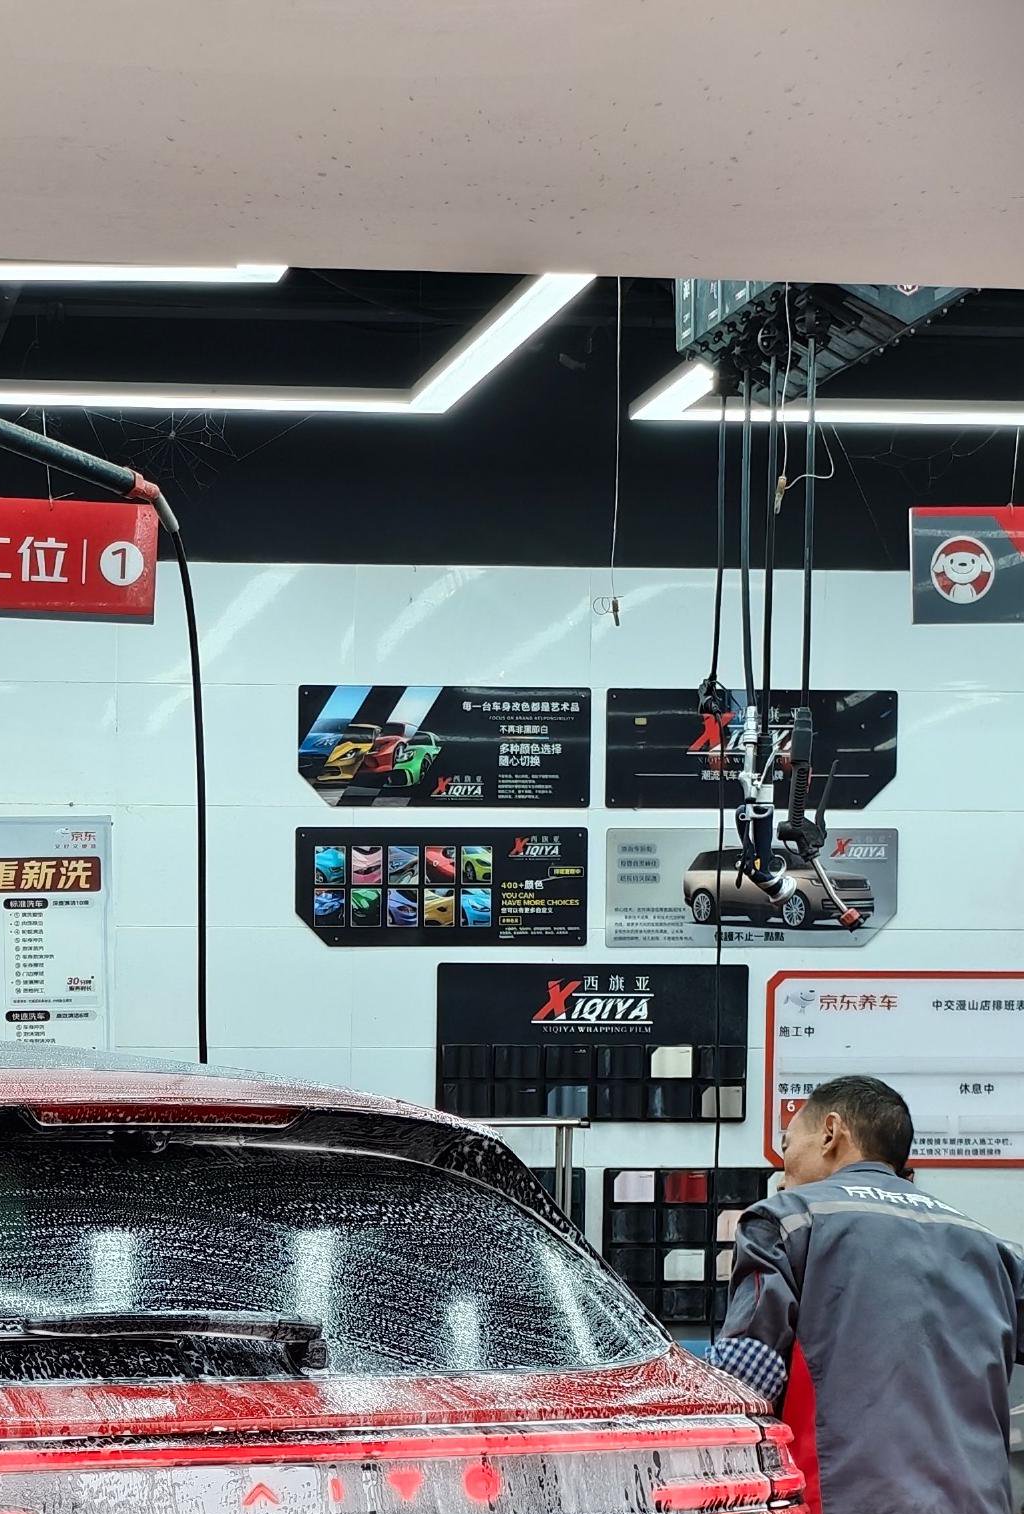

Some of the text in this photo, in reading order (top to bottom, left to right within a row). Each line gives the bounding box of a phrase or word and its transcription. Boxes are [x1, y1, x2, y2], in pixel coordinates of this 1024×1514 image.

[462, 701, 580, 713] 每一台车身改色都是艺术品
[499, 743, 563, 755] 多种颜色选择
[498, 755, 541, 767] 随心切换
[70, 831, 97, 842] 京东
[583, 974, 651, 992] 西旗亚
[532, 977, 652, 1021] XIQIYA
[819, 993, 898, 1012] 京东养车
[542, 1025, 652, 1034] XIQIYA WRAPPING FILM
[779, 1025, 816, 1038] 施工中
[959, 1082, 995, 1095] 休息中
[786, 1100, 796, 1112] 6
